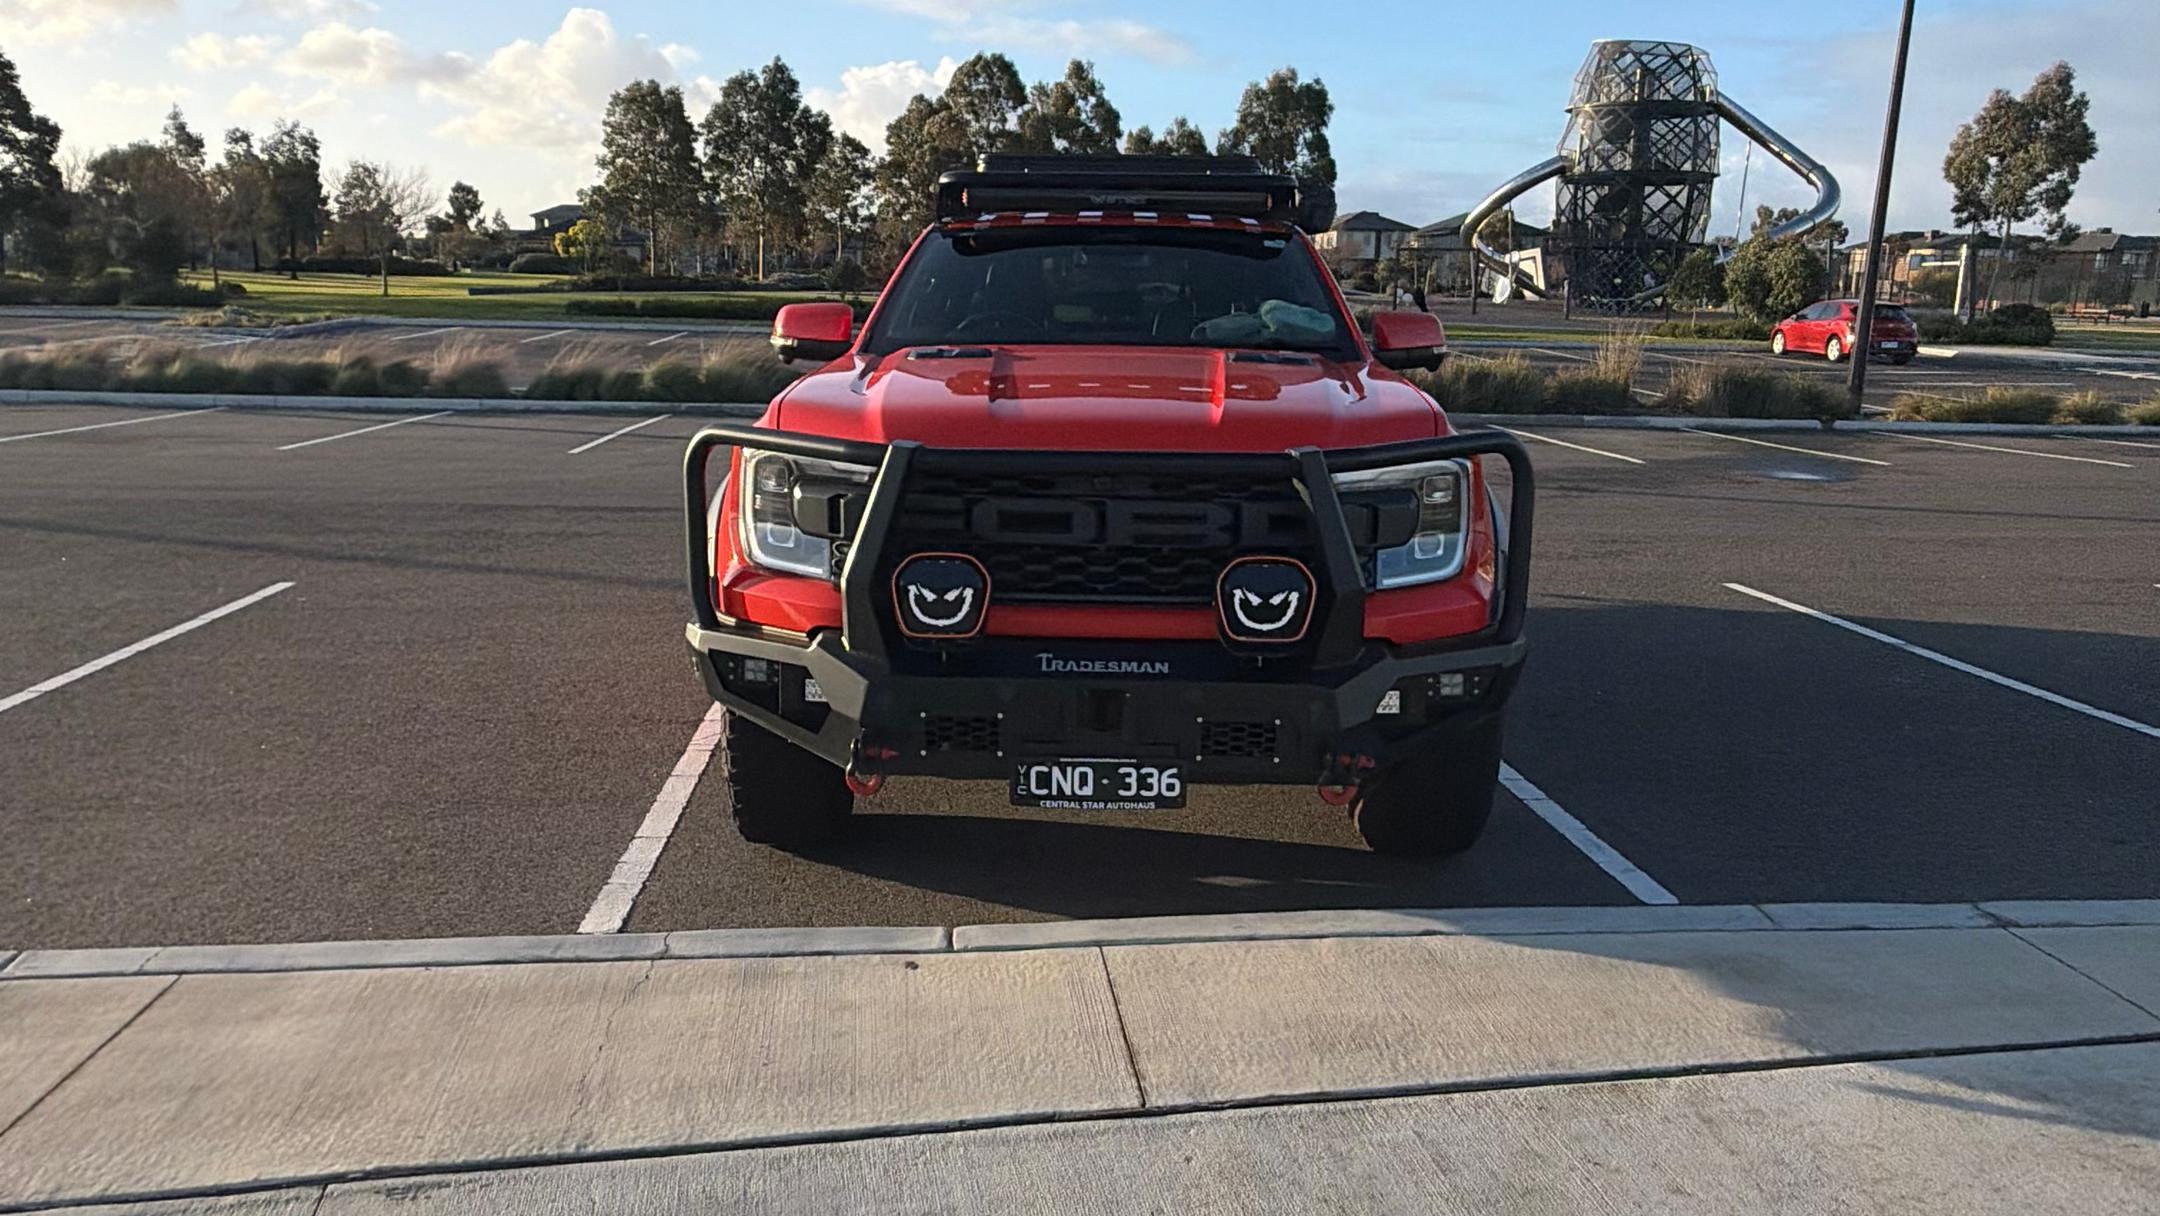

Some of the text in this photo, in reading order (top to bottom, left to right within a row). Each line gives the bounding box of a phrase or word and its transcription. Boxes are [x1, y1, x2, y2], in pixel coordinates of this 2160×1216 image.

[1035, 653, 1169, 673] TRADESMAN
[1017, 764, 1027, 794] VIC
[1029, 765, 1181, 797] CNQ 336
[1040, 800, 1155, 809] CENTRAL STAR AUTOHAUS
